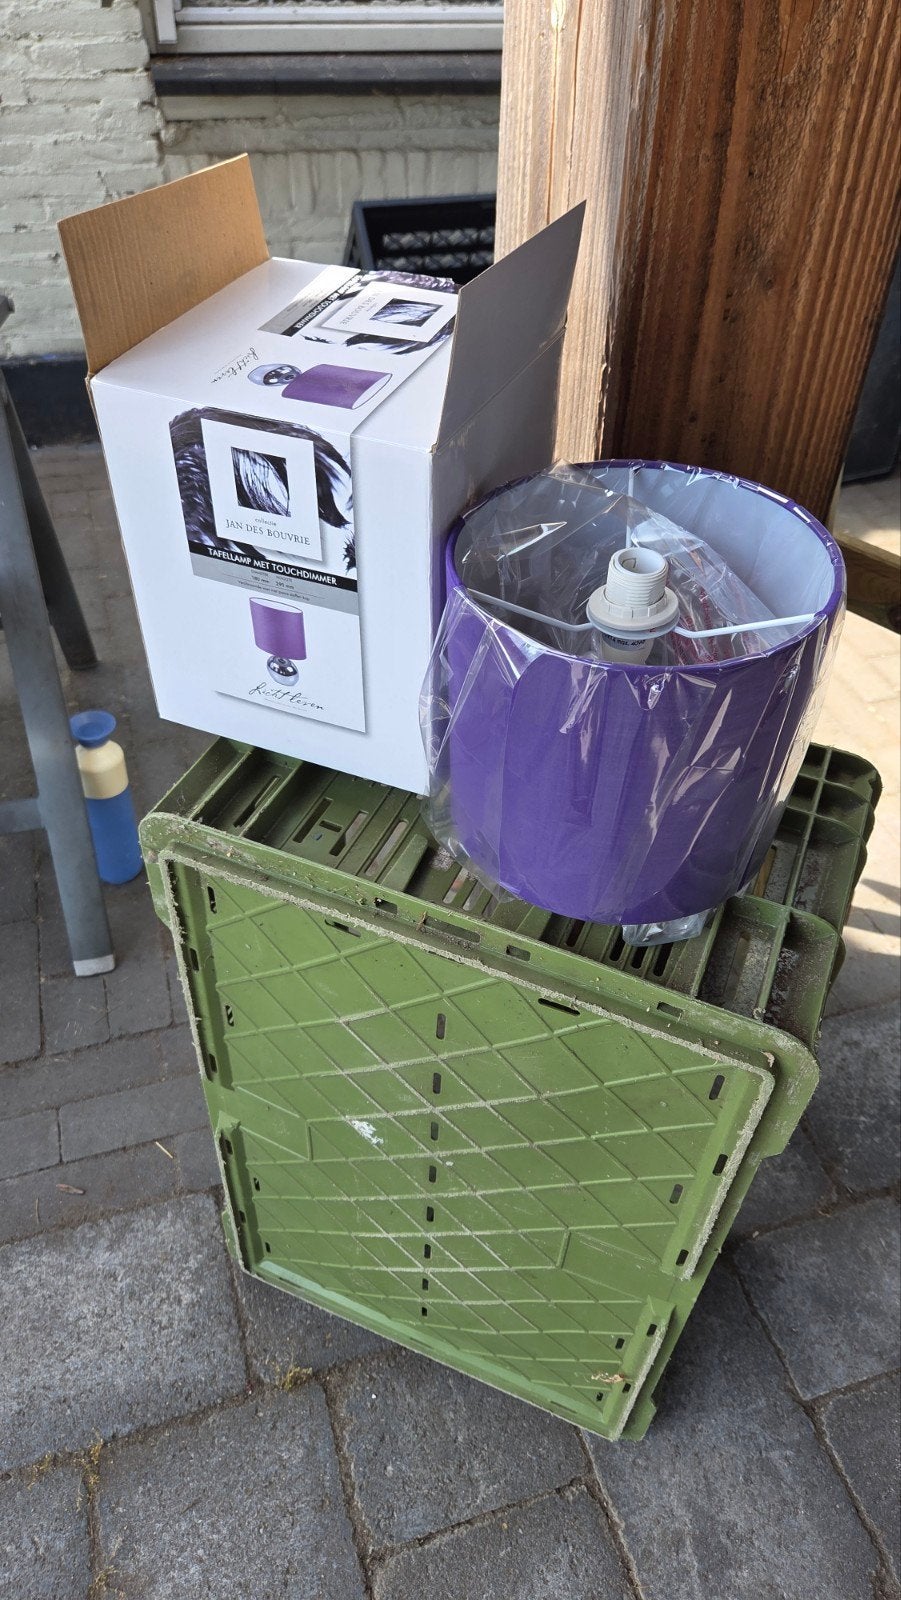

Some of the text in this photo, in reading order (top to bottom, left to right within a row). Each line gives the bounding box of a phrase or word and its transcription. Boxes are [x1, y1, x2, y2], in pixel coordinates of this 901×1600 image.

[225, 519, 311, 546] JAN DES BOUVRIE
[208, 547, 337, 586] TAFELLAMP MET TOUCHDIMMER
